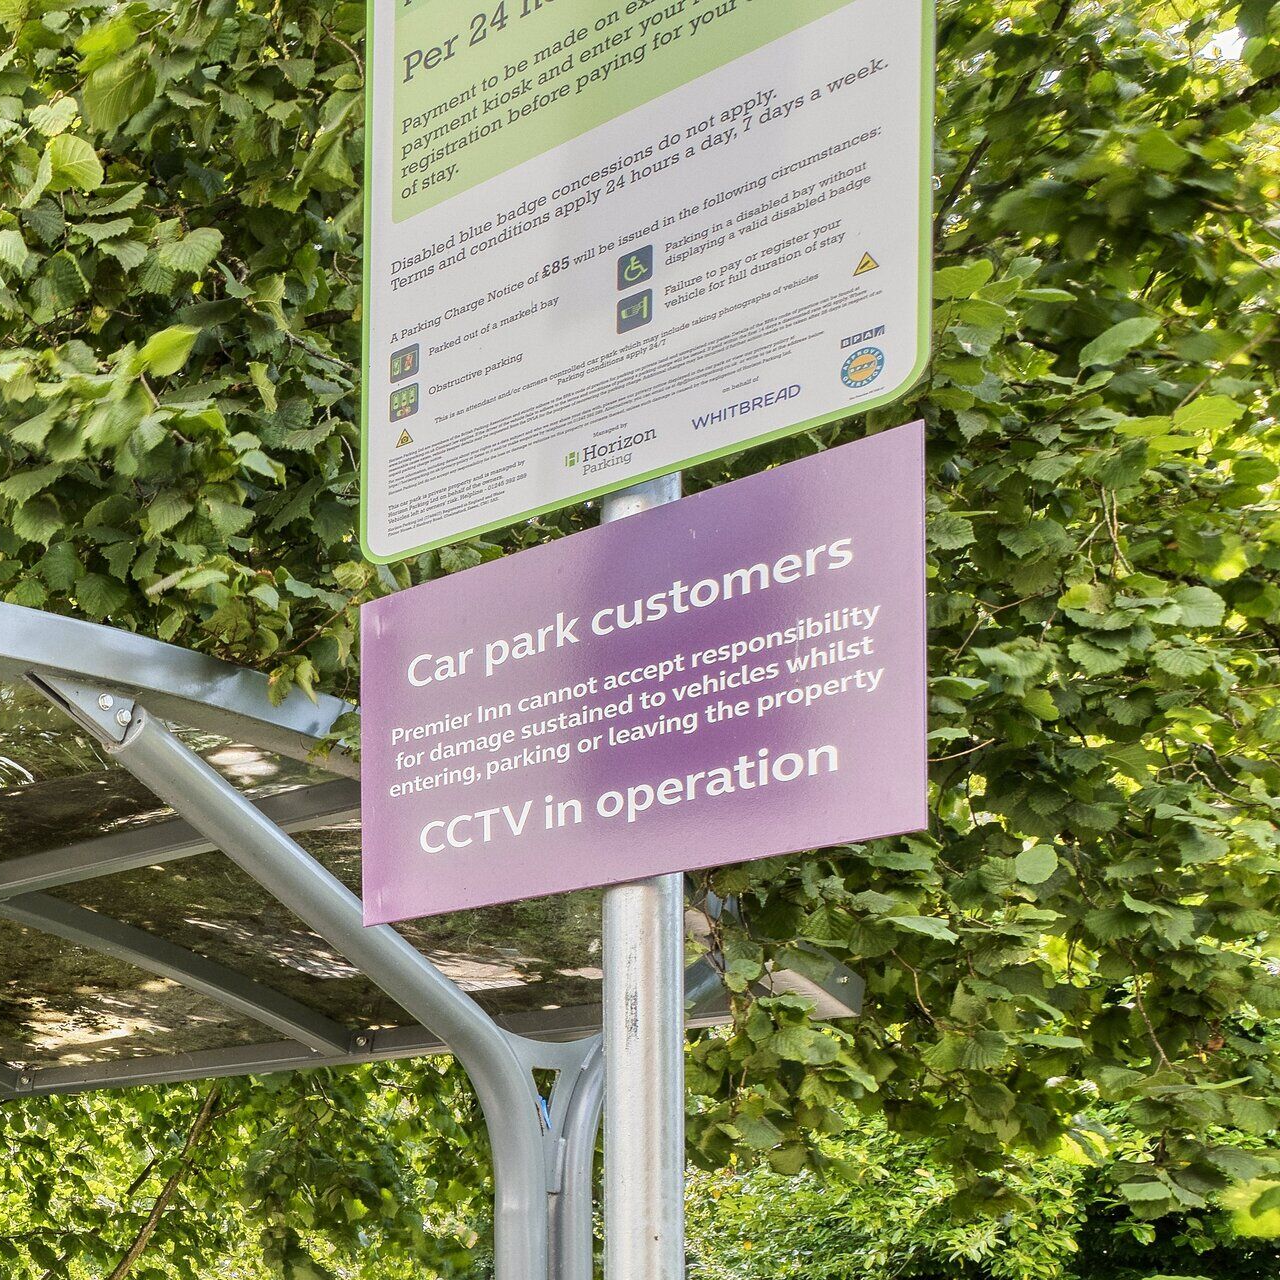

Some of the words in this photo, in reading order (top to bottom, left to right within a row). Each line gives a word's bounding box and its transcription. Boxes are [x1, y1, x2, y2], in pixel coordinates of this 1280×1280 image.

[400, 105, 478, 162] payment
[481, 78, 533, 116] kiosk
[537, 53, 575, 86] and
[578, 25, 634, 63] enter
[637, 0, 689, 38] your
[401, 83, 477, 135] Payment
[480, 75, 499, 92] to
[503, 59, 529, 82] be
[532, 27, 589, 66] made
[593, 10, 620, 32] on
[402, 34, 459, 84] Per
[469, 0, 509, 48] 24
[400, 118, 503, 179] registration
[506, 83, 571, 125] before
[574, 42, 648, 95] paying
[651, 23, 684, 51] for
[687, 0, 739, 37] your
[389, 264, 435, 292] Terms
[437, 246, 467, 271] and
[469, 211, 551, 256] conditions
[554, 187, 602, 218] apply
[605, 173, 626, 195] 24
[629, 151, 680, 184] hours
[684, 145, 696, 159] a
[700, 126, 738, 151] day,
[741, 114, 753, 133] 7
[758, 95, 805, 124] days
[809, 88, 822, 102] a
[826, 58, 889, 93] week.
[390, 234, 456, 276] Disabled
[458, 220, 493, 244] blue
[495, 195, 547, 227] badge
[551, 145, 653, 201] concessions
[657, 133, 681, 151] do
[685, 114, 715, 140] not
[719, 88, 777, 123] apply.
[400, 177, 419, 200] of
[421, 162, 459, 191] stay.
[664, 227, 710, 253] Parking
[711, 222, 724, 234] in
[725, 218, 733, 227] a
[735, 192, 790, 223] disabled
[791, 183, 817, 201] bay
[818, 161, 867, 188] without
[664, 234, 726, 266] displaying
[727, 231, 736, 240] a
[737, 214, 769, 236] valid
[770, 190, 827, 223] disabled
[828, 175, 871, 199] badge
[389, 331, 399, 345] A
[399, 315, 442, 340] Parking
[443, 297, 485, 320] Charge
[486, 280, 525, 303] Notice
[526, 270, 540, 285] of
[541, 254, 570, 279] £85
[572, 246, 596, 265] will
[597, 241, 615, 256] be
[617, 219, 660, 247] issued
[662, 215, 676, 228] in
[678, 205, 700, 221] the
[702, 174, 768, 211] following
[770, 125, 882, 181] circumstances:
[663, 274, 703, 297] Failure
[705, 269, 717, 280] to
[718, 258, 743, 277] pay
[744, 251, 759, 264] or
[759, 231, 810, 259] register
[812, 218, 842, 240] your
[663, 287, 706, 309] vehicle
[707, 278, 726, 293] for
[727, 267, 748, 285] full
[749, 249, 802, 276] duration
[804, 239, 818, 254] of
[819, 231, 846, 249] stay
[428, 335, 462, 357] Parked
[462, 328, 479, 342] out
[479, 322, 491, 335] of
[491, 322, 498, 330] a
[499, 302, 538, 327] marked
[539, 296, 560, 311] bay
[433, 414, 449, 424] This
[448, 411, 456, 419] is
[455, 408, 465, 416] an
[464, 395, 497, 413] attendant
[497, 386, 521, 400] and/or
[521, 376, 548, 391] camera
[548, 360, 586, 381] controlled
[586, 356, 600, 366] car
[599, 348, 618, 363] park
[617, 340, 642, 354] which
[642, 333, 660, 346] may
[660, 322, 691, 339] include
[690, 311, 718, 327] taking
[717, 291, 771, 318] photographs
[772, 285, 782, 296] of
[782, 273, 819, 292] vehicles
[556, 369, 585, 386] Parking
[585, 355, 625, 375] conditions
[625, 346, 648, 360] apply
[648, 337, 667, 351] 24/7
[842, 348, 884, 372] APPROVED
[427, 368, 483, 395] Obstructive
[484, 352, 524, 376] parking
[691, 383, 801, 430] WHITBREAD
[581, 449, 633, 476] Parking
[582, 428, 657, 463] Horizon
[407, 647, 474, 687] Car
[485, 611, 579, 677] park
[591, 537, 853, 636] customers
[391, 712, 473, 746] Premier
[477, 702, 512, 723] Inn
[517, 676, 598, 712] cannot
[603, 653, 685, 690] accept
[691, 604, 881, 668] responsibility
[394, 750, 425, 771] for
[429, 729, 515, 762] damage
[520, 693, 633, 740] sustained
[638, 691, 666, 710] to
[671, 662, 779, 701] vehicles
[785, 635, 874, 674] whilst
[389, 765, 482, 798] entering,
[486, 742, 570, 780] parking
[576, 734, 603, 753] or
[608, 711, 698, 746] leaving
[704, 700, 750, 723] the
[757, 667, 885, 718] property
[419, 799, 533, 854] CCTV
[544, 794, 582, 830] in
[596, 744, 839, 823] operation
